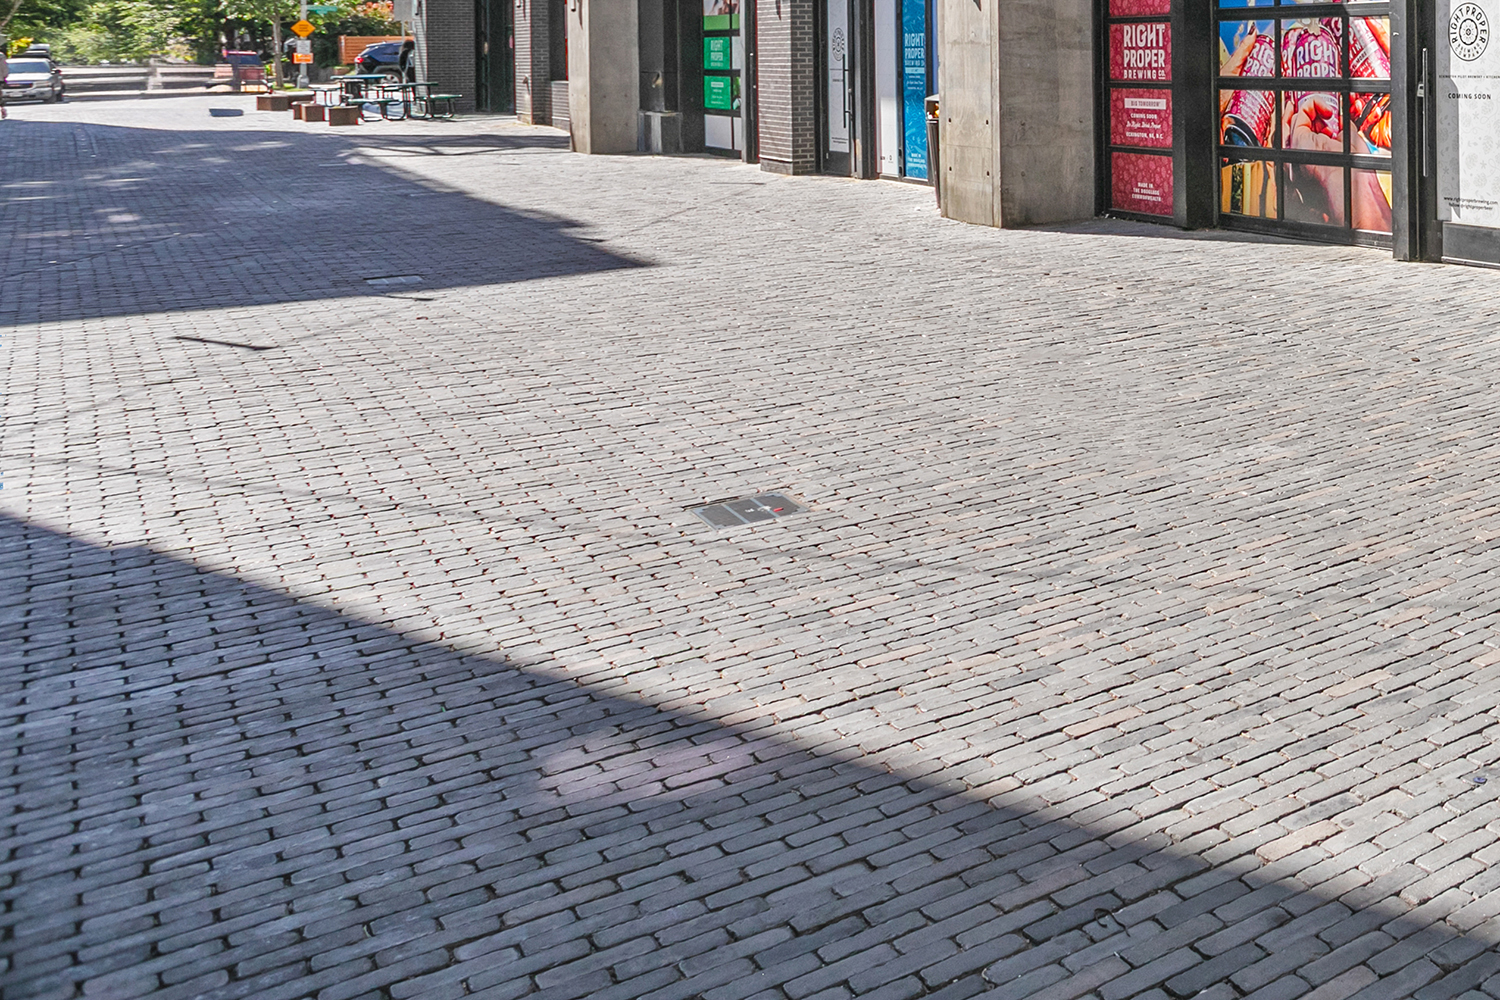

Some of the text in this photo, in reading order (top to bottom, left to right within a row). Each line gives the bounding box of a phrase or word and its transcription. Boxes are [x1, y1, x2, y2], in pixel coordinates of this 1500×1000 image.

[904, 32, 925, 47] RIGHT
[1123, 24, 1165, 47] RIGHT
[904, 47, 925, 59] PROPER
[1123, 49, 1165, 68] PROPER
[1123, 69, 1157, 79] BREWING
[1447, 92, 1492, 101] COMING SOON
